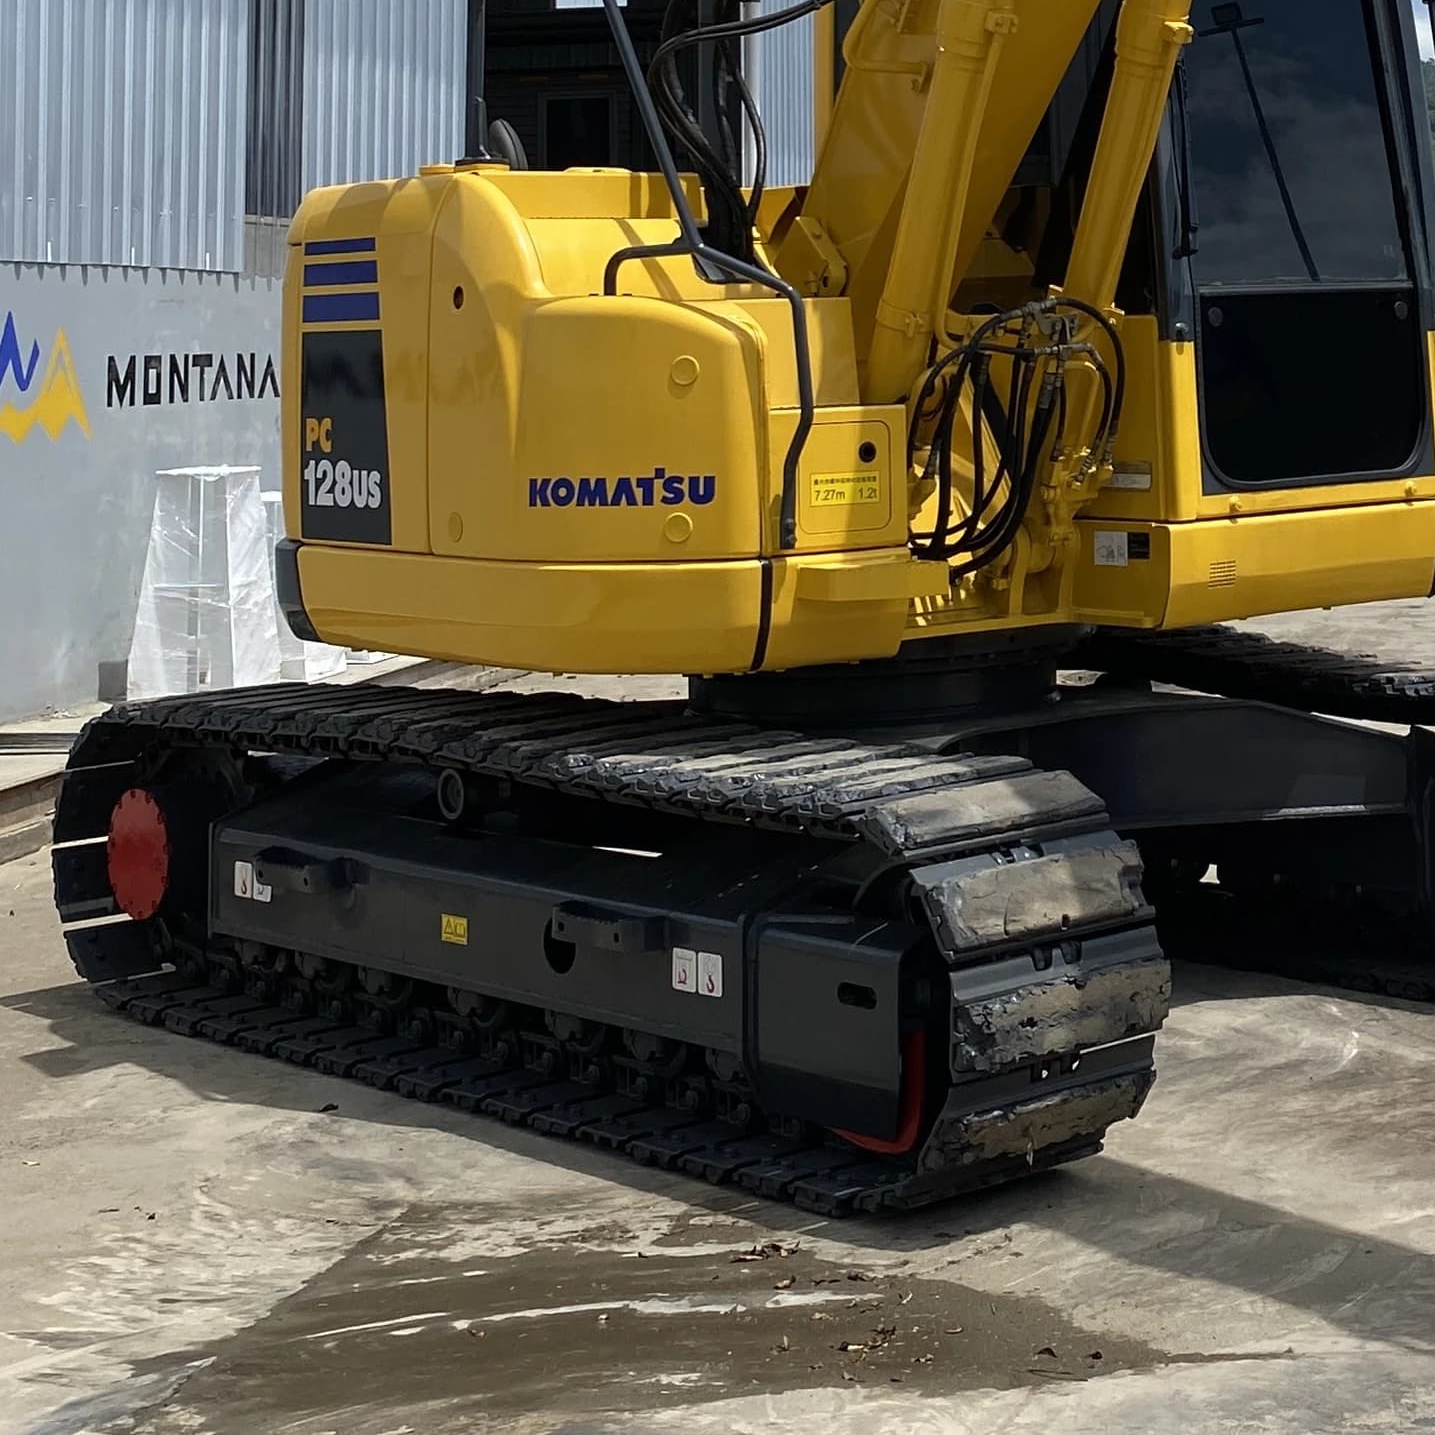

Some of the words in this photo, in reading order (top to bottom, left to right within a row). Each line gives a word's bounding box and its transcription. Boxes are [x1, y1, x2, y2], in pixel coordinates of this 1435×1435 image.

[106, 353, 280, 409] MONTANA
[306, 418, 332, 453] PC
[529, 467, 716, 507] KOMATSU
